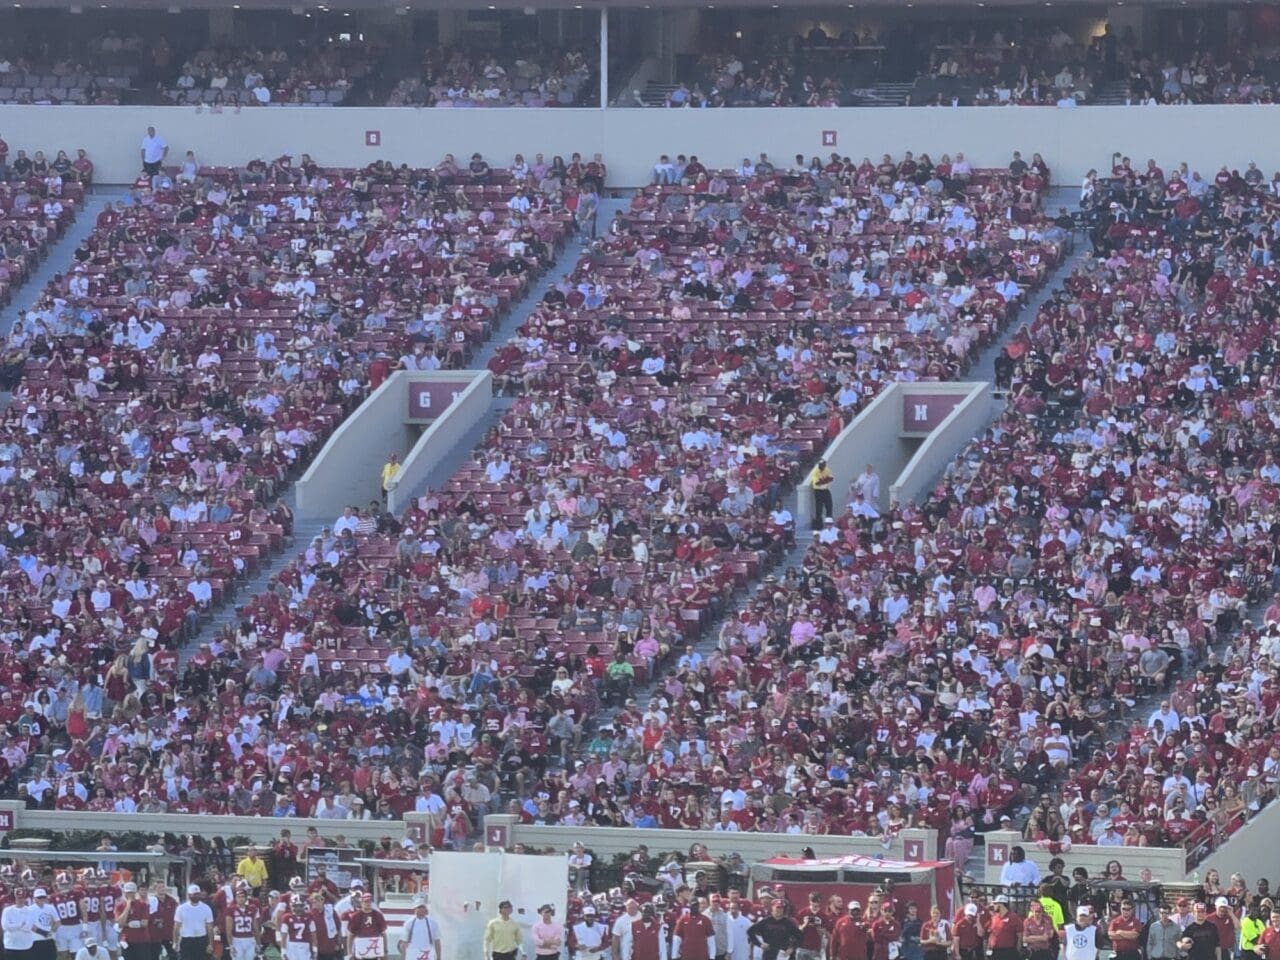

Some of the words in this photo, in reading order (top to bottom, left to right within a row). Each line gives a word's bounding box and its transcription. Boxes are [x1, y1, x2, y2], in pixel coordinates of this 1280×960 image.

[419, 392, 431, 408] G
[914, 404, 928, 421] H
[492, 829, 500, 842] J
[909, 843, 918, 857] J
[993, 848, 1003, 861] K
[235, 917, 251, 933] 23
[293, 923, 306, 939] 7
